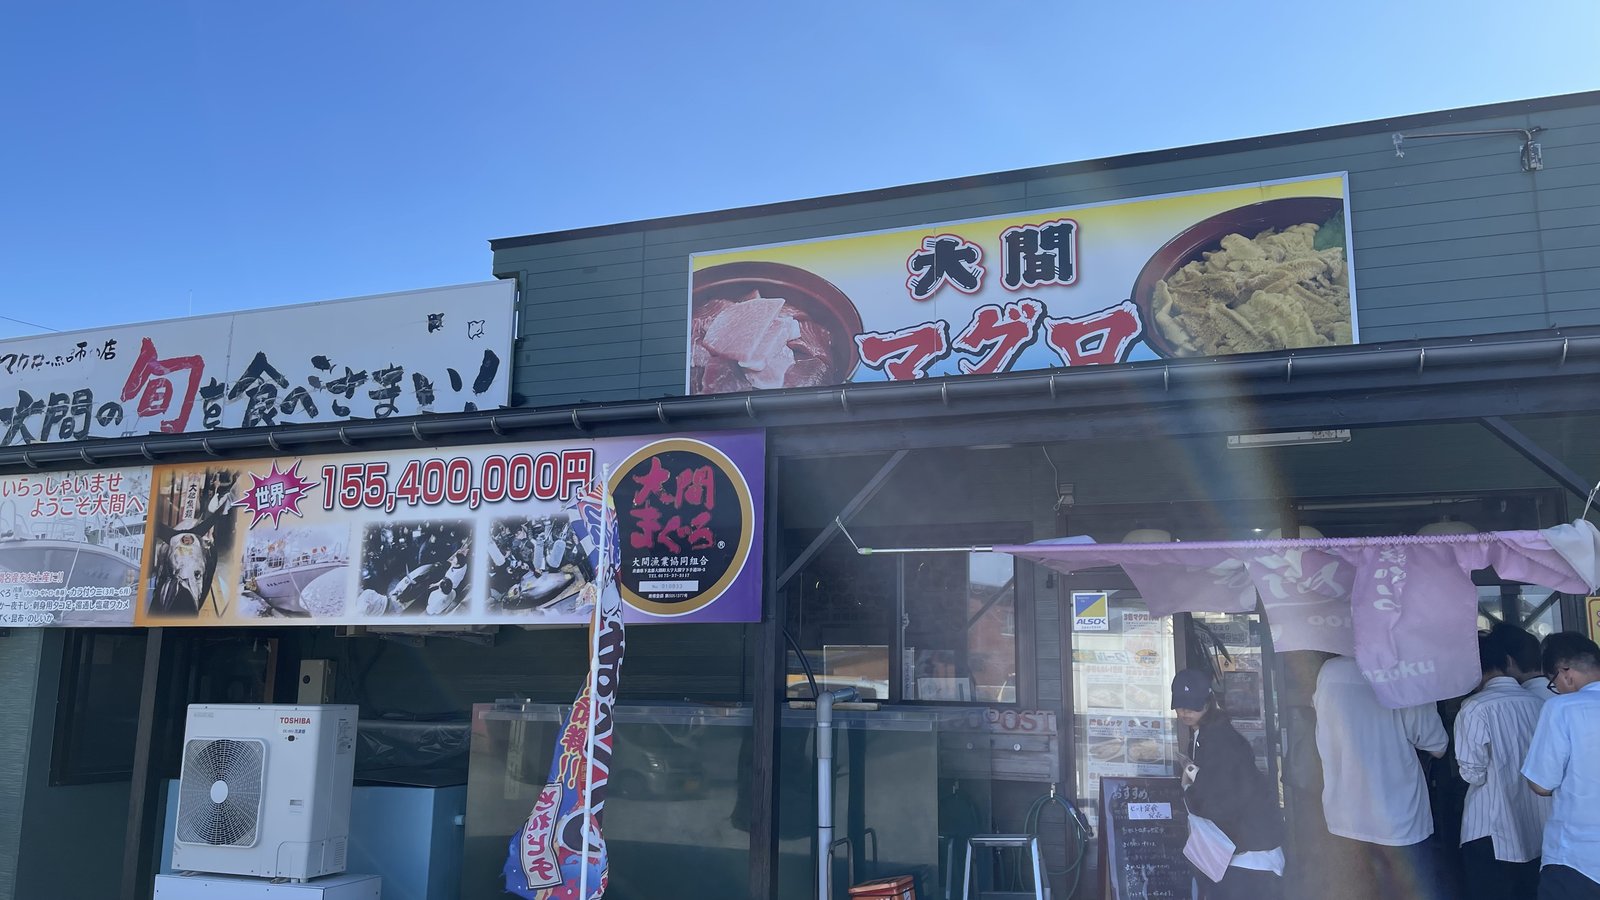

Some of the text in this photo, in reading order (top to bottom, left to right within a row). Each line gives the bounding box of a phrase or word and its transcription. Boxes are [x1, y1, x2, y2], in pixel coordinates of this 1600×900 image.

[906, 219, 1082, 300] 大間
[854, 299, 1144, 382] マグロ
[2, 471, 123, 498] いらっしゃいませ
[321, 449, 595, 513] 155,400,000円
[632, 456, 715, 511] 大間
[30, 493, 145, 518] ようこそ大間へ
[255, 482, 300, 511] 世界一
[630, 503, 715, 554] まぐろ
[632, 555, 709, 567] 大間漁業協同組合
[280, 717, 311, 725] TOSHIBA
[984, 708, 1055, 732] POST
[1112, 785, 1148, 800] おすすめ
